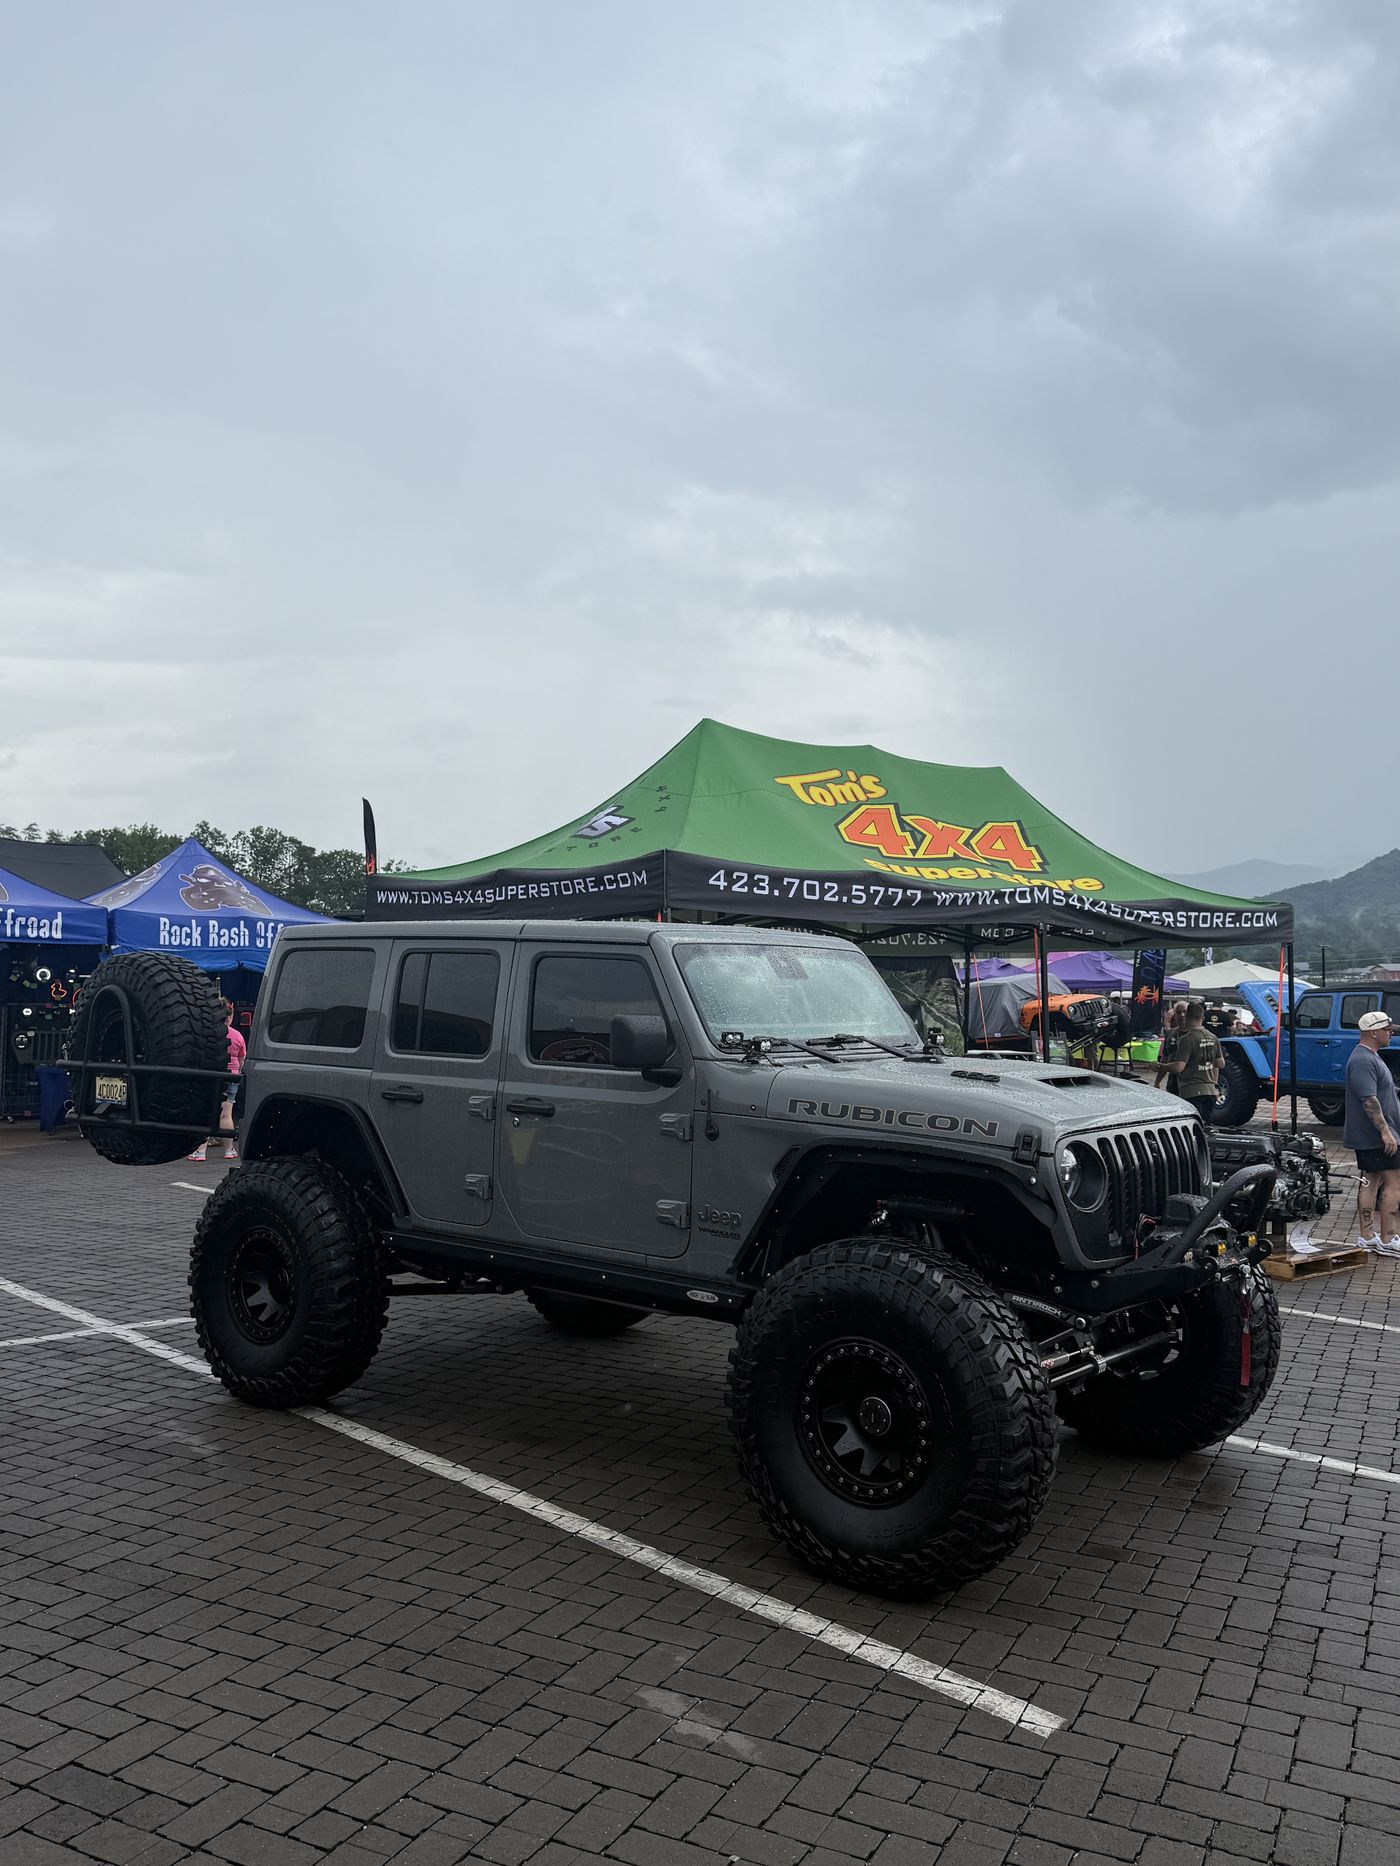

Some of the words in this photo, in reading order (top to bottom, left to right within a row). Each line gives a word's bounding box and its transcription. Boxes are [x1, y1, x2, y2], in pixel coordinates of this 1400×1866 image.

[774, 768, 889, 808] Tom's
[376, 869, 648, 905] WWW.TOMS4X4SUPERSTORE.COM
[708, 869, 923, 907] 423.702.5777
[0, 907, 62, 940] froad
[159, 917, 202, 947] Rock
[208, 919, 249, 948] Rash
[787, 1098, 999, 1138] RUBICON
[698, 1204, 742, 1231] Jeep
[1012, 1295, 1062, 1317] ANTIROCK
